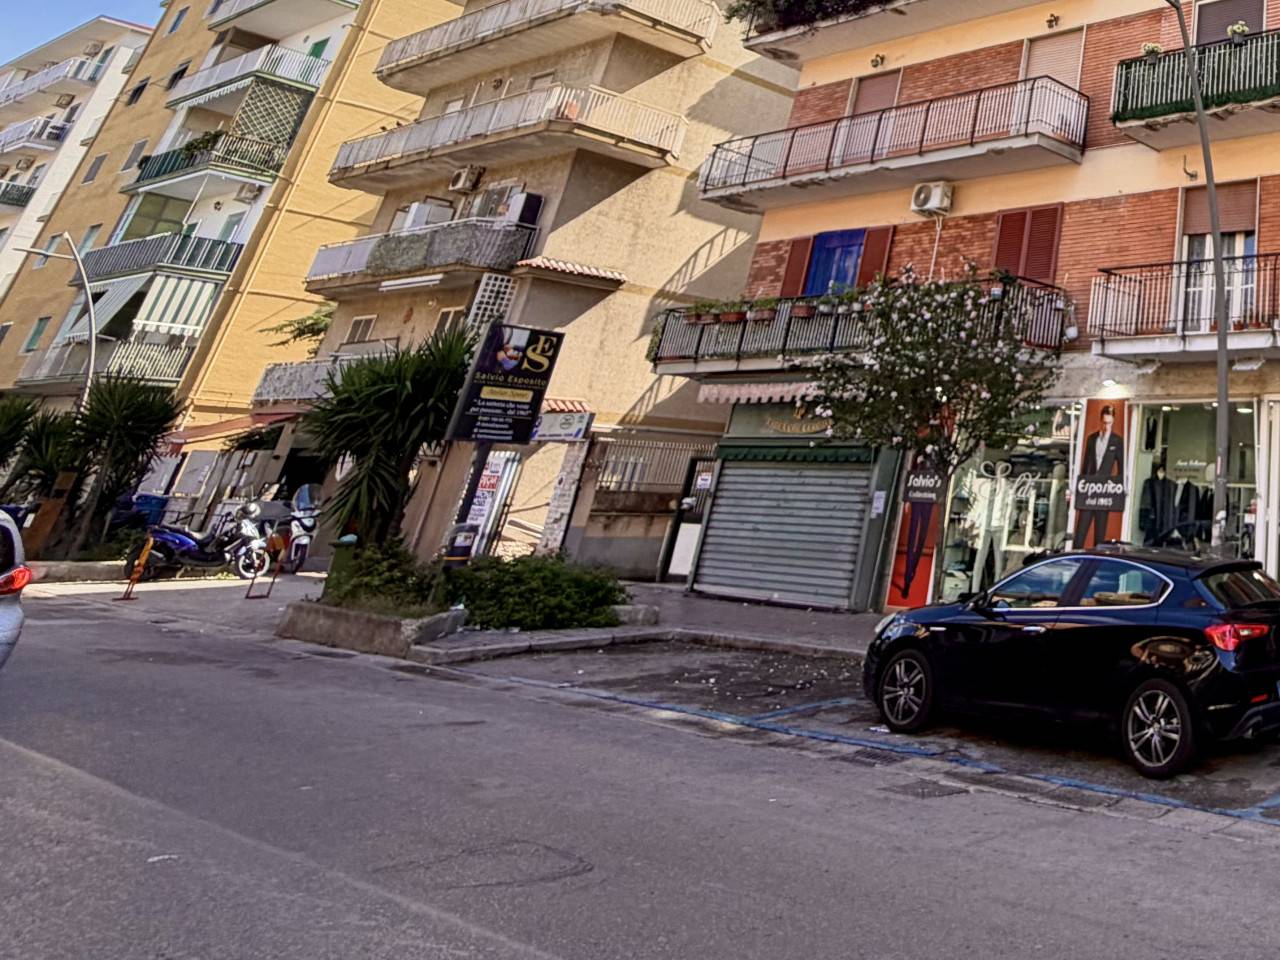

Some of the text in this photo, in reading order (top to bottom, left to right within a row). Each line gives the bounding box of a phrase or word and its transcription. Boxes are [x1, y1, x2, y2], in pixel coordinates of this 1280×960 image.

[507, 375, 547, 387] Esposito
[907, 474, 942, 488] Salvio's
[979, 460, 1041, 500] Sldi
[1078, 479, 1123, 496] Esposito
